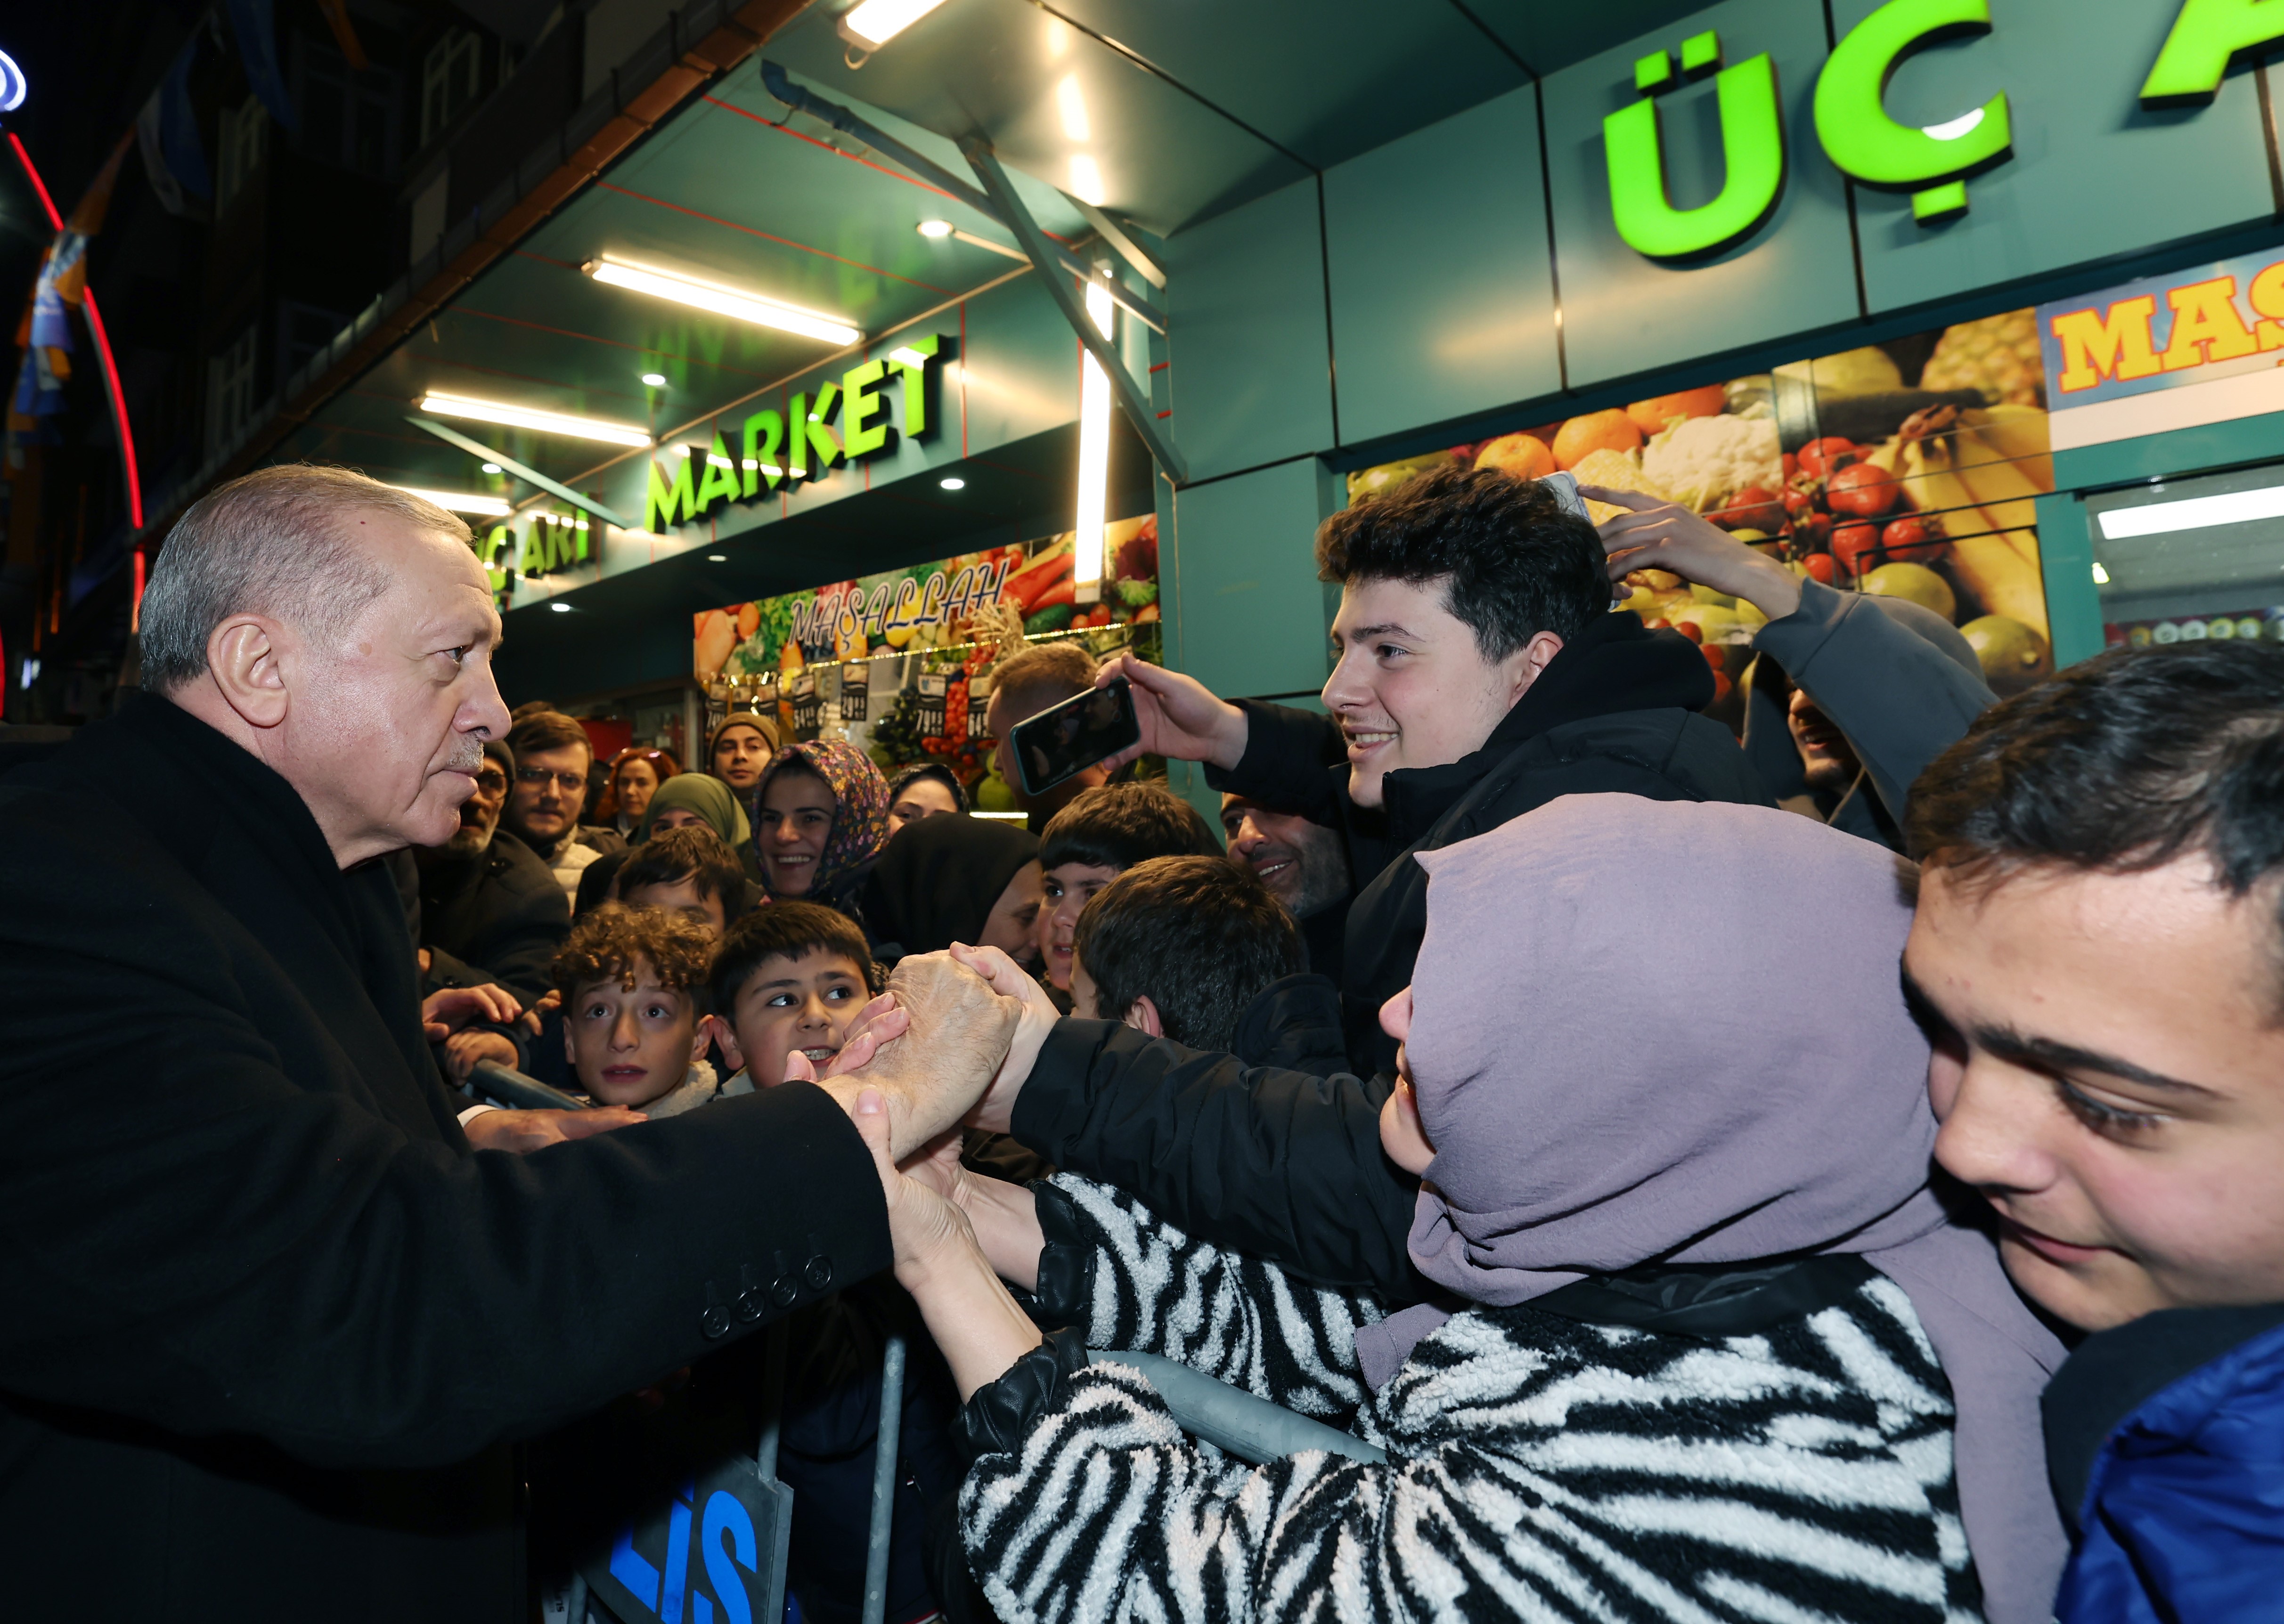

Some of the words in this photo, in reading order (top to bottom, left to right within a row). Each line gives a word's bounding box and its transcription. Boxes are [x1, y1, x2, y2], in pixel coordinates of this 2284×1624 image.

[1603, 0, 2014, 258] ÜÇ
[644, 333, 940, 533] MARKET
[789, 556, 1011, 654] MAŞALLAH
